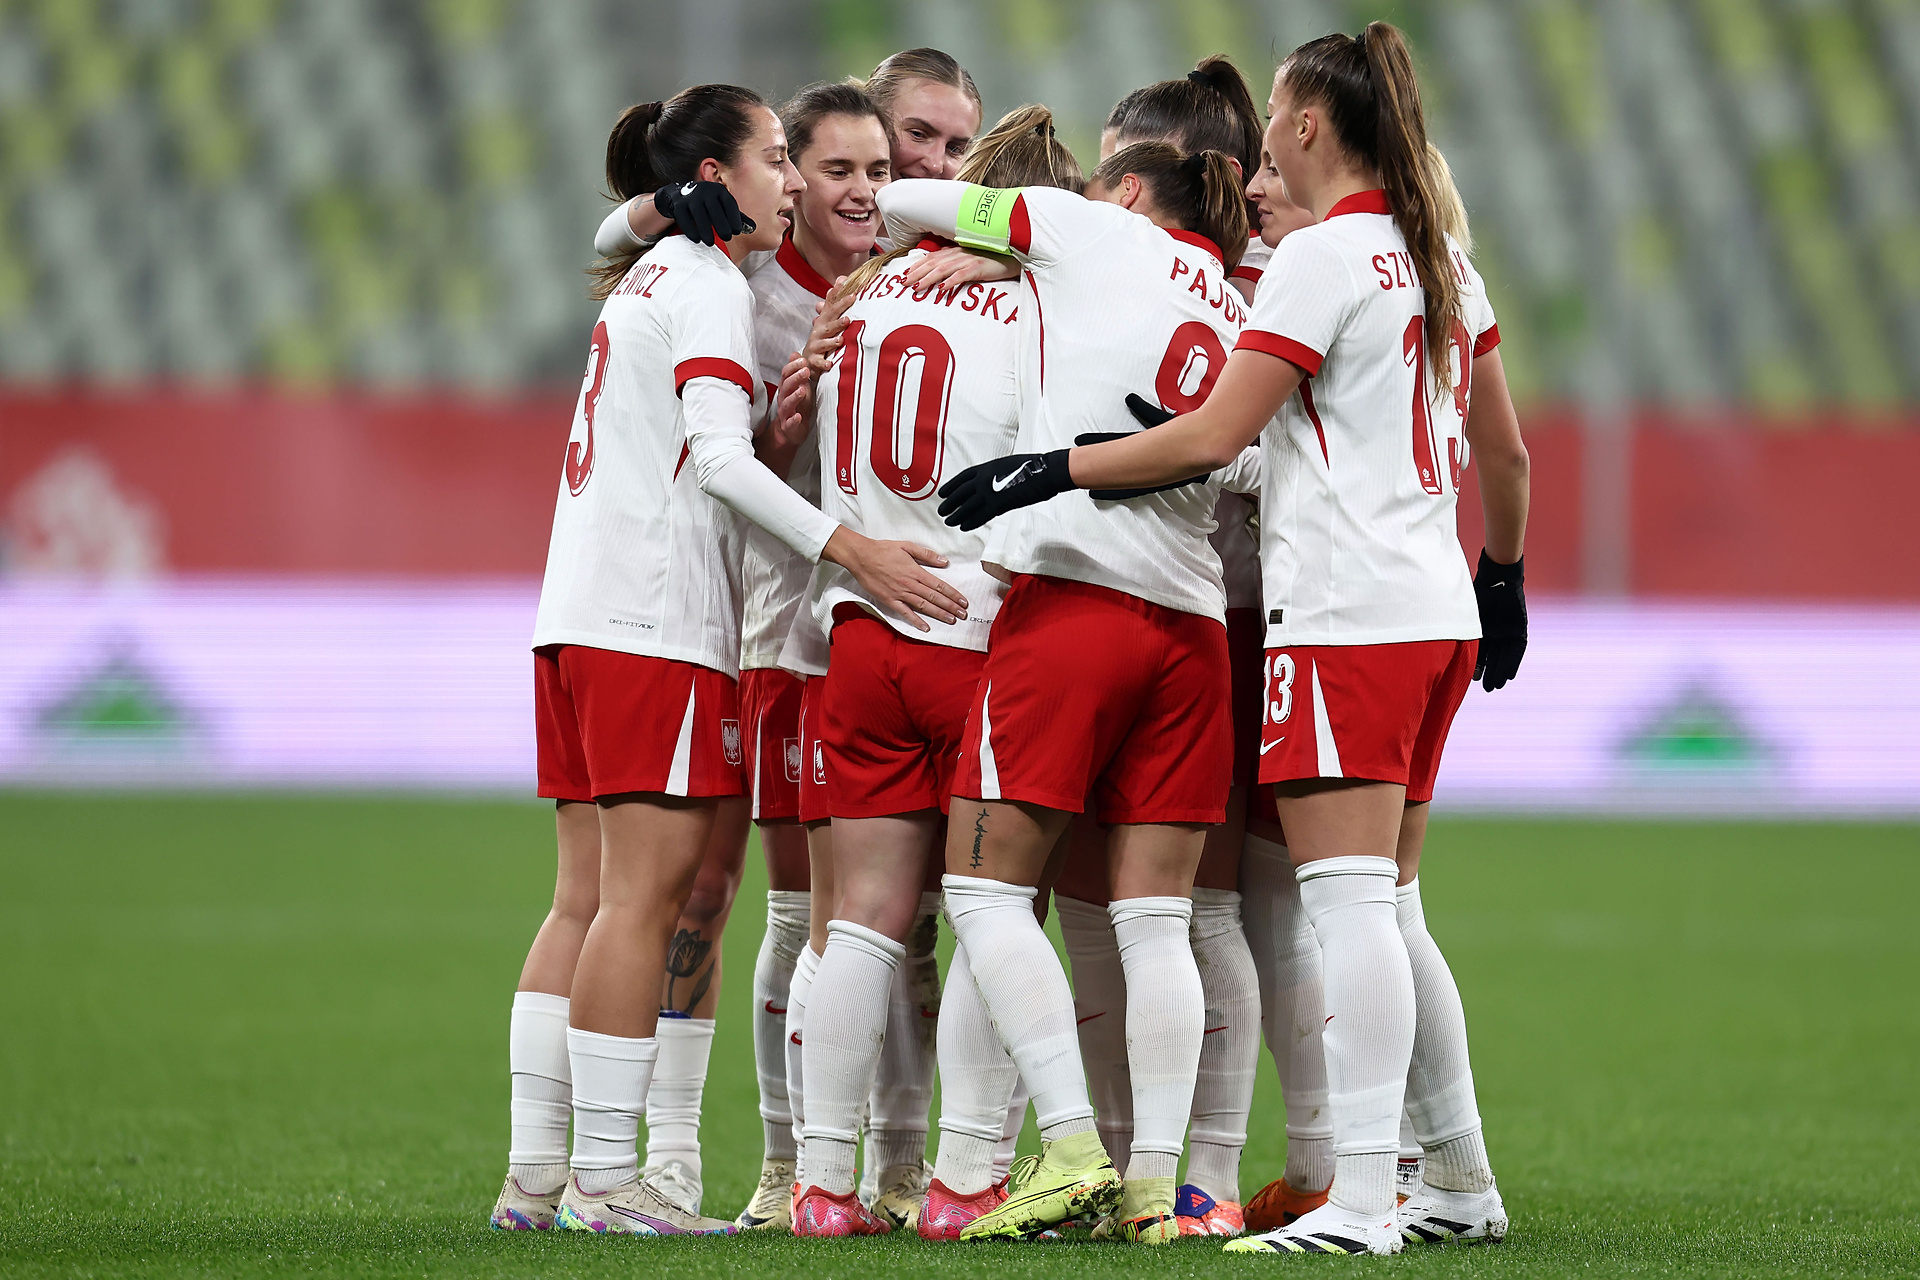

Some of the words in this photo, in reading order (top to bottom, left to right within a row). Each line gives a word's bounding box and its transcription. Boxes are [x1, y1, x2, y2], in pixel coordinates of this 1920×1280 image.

[829, 320, 956, 501] 10
[1403, 315, 1472, 496] 13
[1263, 653, 1296, 726] 13
[1402, 1173, 1410, 1182] 8
